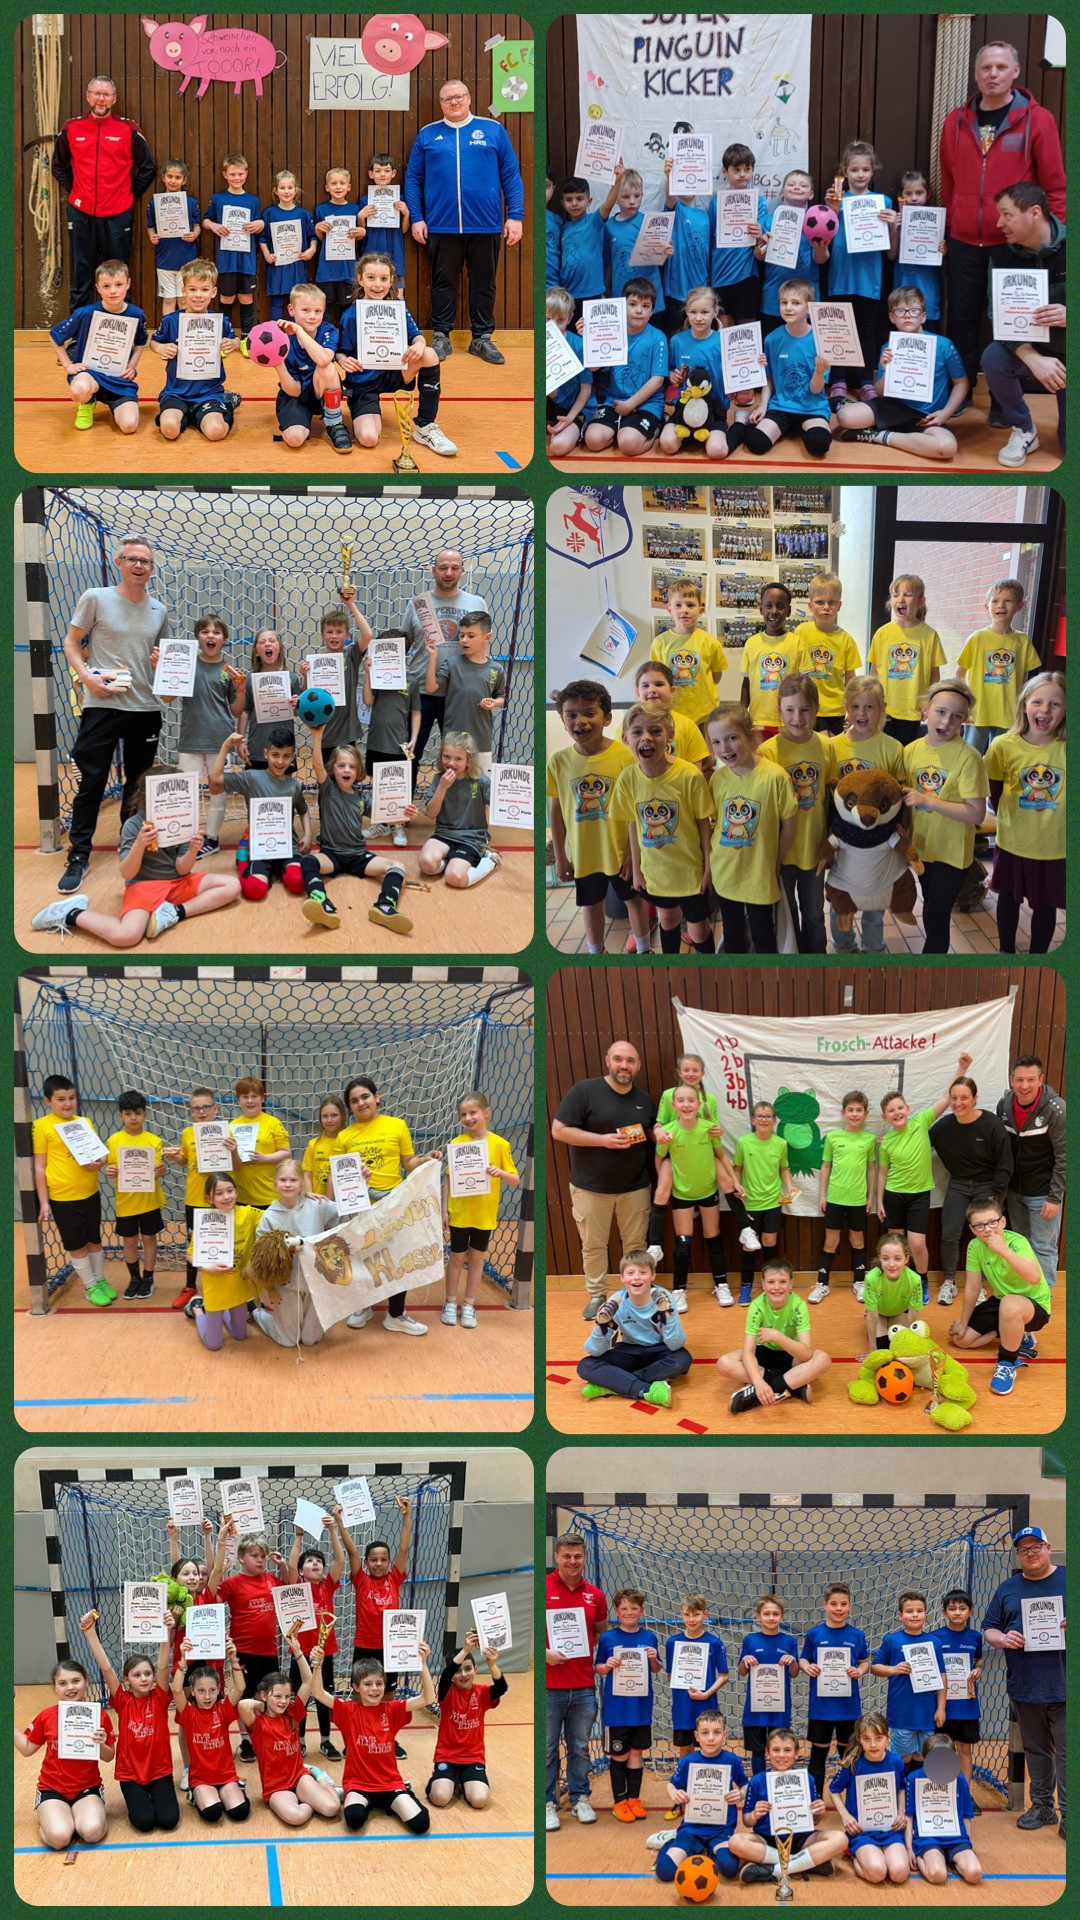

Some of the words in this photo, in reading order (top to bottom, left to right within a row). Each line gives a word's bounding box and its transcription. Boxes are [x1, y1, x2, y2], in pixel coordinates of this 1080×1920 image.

[633, 27, 744, 63] PINGUIN
[316, 44, 370, 66] VIEL
[313, 72, 393, 100] ERFOLG!
[644, 67, 734, 98] KICKER
[589, 125, 616, 141] URKUNDE
[677, 138, 704, 152] URKUNDE
[374, 188, 394, 198] URKUNDE
[725, 194, 750, 207] URKUNDE
[851, 199, 877, 212] URKUNDE
[910, 211, 937, 224] URKUNDE
[1003, 275, 1037, 290] URKUNDE
[366, 305, 396, 319] URKUNDE
[591, 304, 617, 319] URKUNDE
[818, 308, 846, 321] URKUNDE
[99, 319, 128, 334] URKUNDE
[187, 318, 214, 332] URKUNDE
[728, 329, 754, 346] URKUNDE
[897, 338, 927, 353] URKUNDE
[165, 642, 191, 655] URKUNDE
[375, 641, 398, 654] URKUNDE
[314, 658, 337, 670] URKUNDE
[260, 675, 283, 688] URKUNDE
[381, 766, 404, 780] URKUNDE
[500, 769, 530, 784] URKUNDE
[156, 779, 189, 796] URKUNDE
[258, 802, 284, 815] URKUNDE
[817, 1036, 871, 1052] Frosch-
[872, 1036, 927, 1050] Attacke
[725, 1073, 746, 1090] 3b
[726, 1092, 747, 1110] 4b
[201, 1124, 222, 1137] URKUNDE
[125, 1150, 148, 1160] URKUNDE
[455, 1146, 481, 1159] URKUNDE
[336, 1158, 358, 1172] URKUNDE
[202, 1212, 226, 1225] URKUNDE
[174, 1480, 194, 1491] URKUNDE
[227, 1483, 252, 1496] URKUNDE
[132, 1587, 159, 1600] URKUNDE
[279, 1588, 304, 1601] URKUNDE
[193, 1608, 217, 1620] URKUNDE
[1030, 1601, 1055, 1614] URKUNDE
[390, 1614, 417, 1626] URKUNDE
[553, 1611, 577, 1622] URKUNDE
[680, 1645, 702, 1656] URKUNDE
[824, 1650, 845, 1662] URKUNDE
[910, 1647, 929, 1658] URKUNDE
[757, 1668, 778, 1678] URKUNDE
[66, 1705, 92, 1719] URKUNDE
[696, 1768, 722, 1782] URKUNDE
[774, 1776, 800, 1787] URKUNDE
[864, 1778, 888, 1792] URKUNDE
